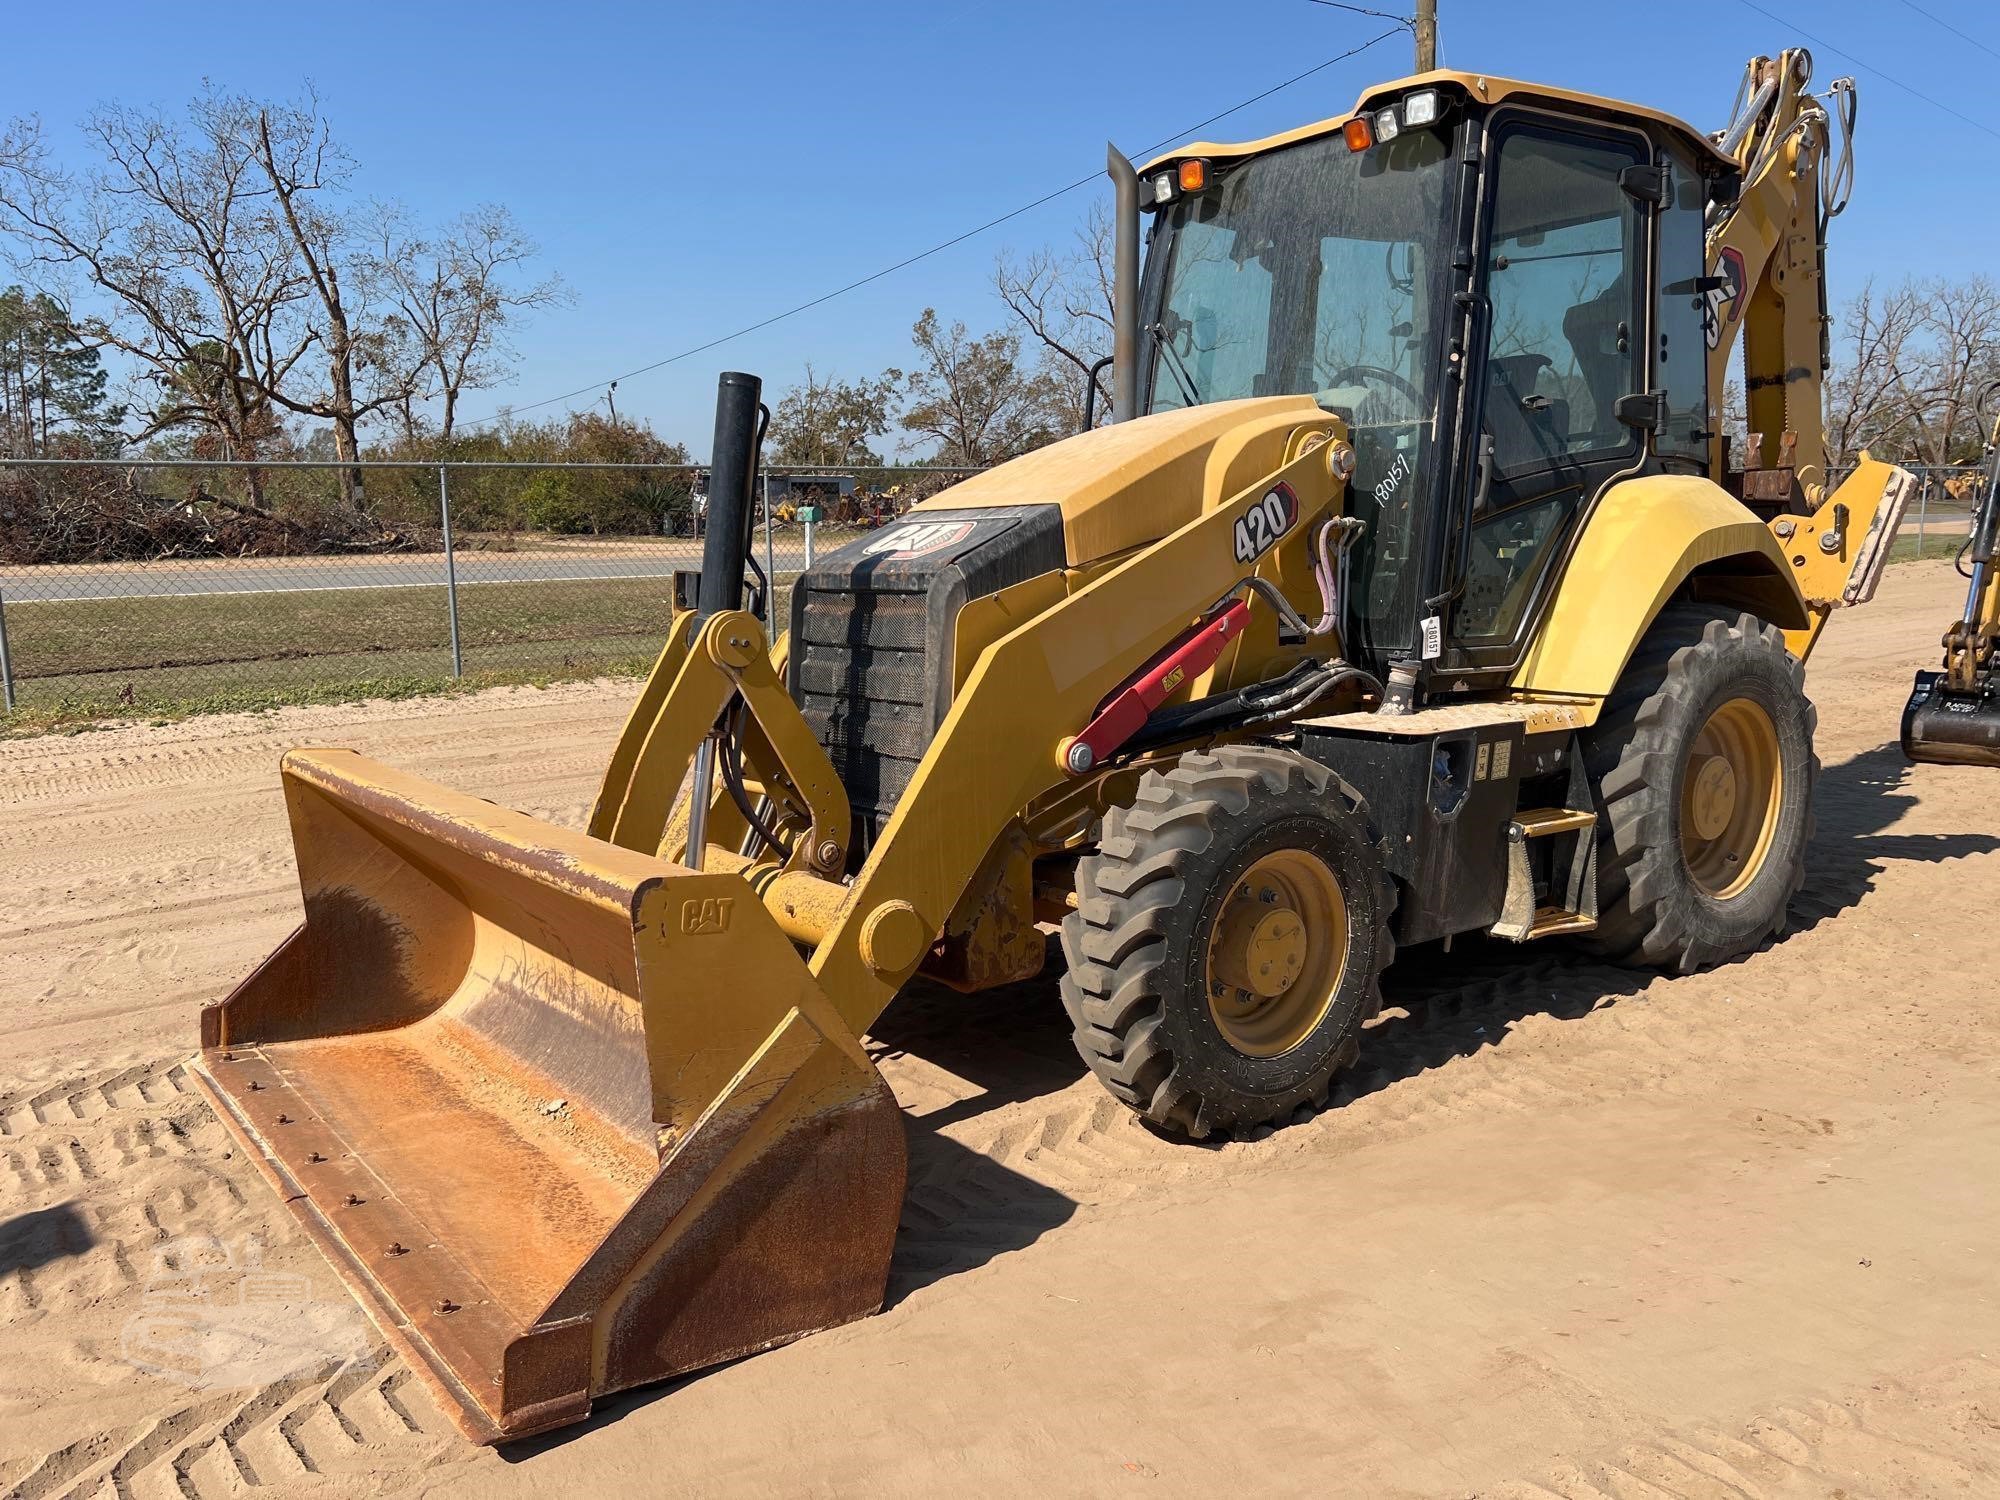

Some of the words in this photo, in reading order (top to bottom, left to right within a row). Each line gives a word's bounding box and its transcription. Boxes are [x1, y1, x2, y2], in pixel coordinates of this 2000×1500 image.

[1372, 453, 1410, 509] 180157
[863, 523, 967, 555] CAT
[1235, 491, 1287, 562] 420
[1428, 625, 1438, 653] 180157
[681, 897, 735, 936] CAT
